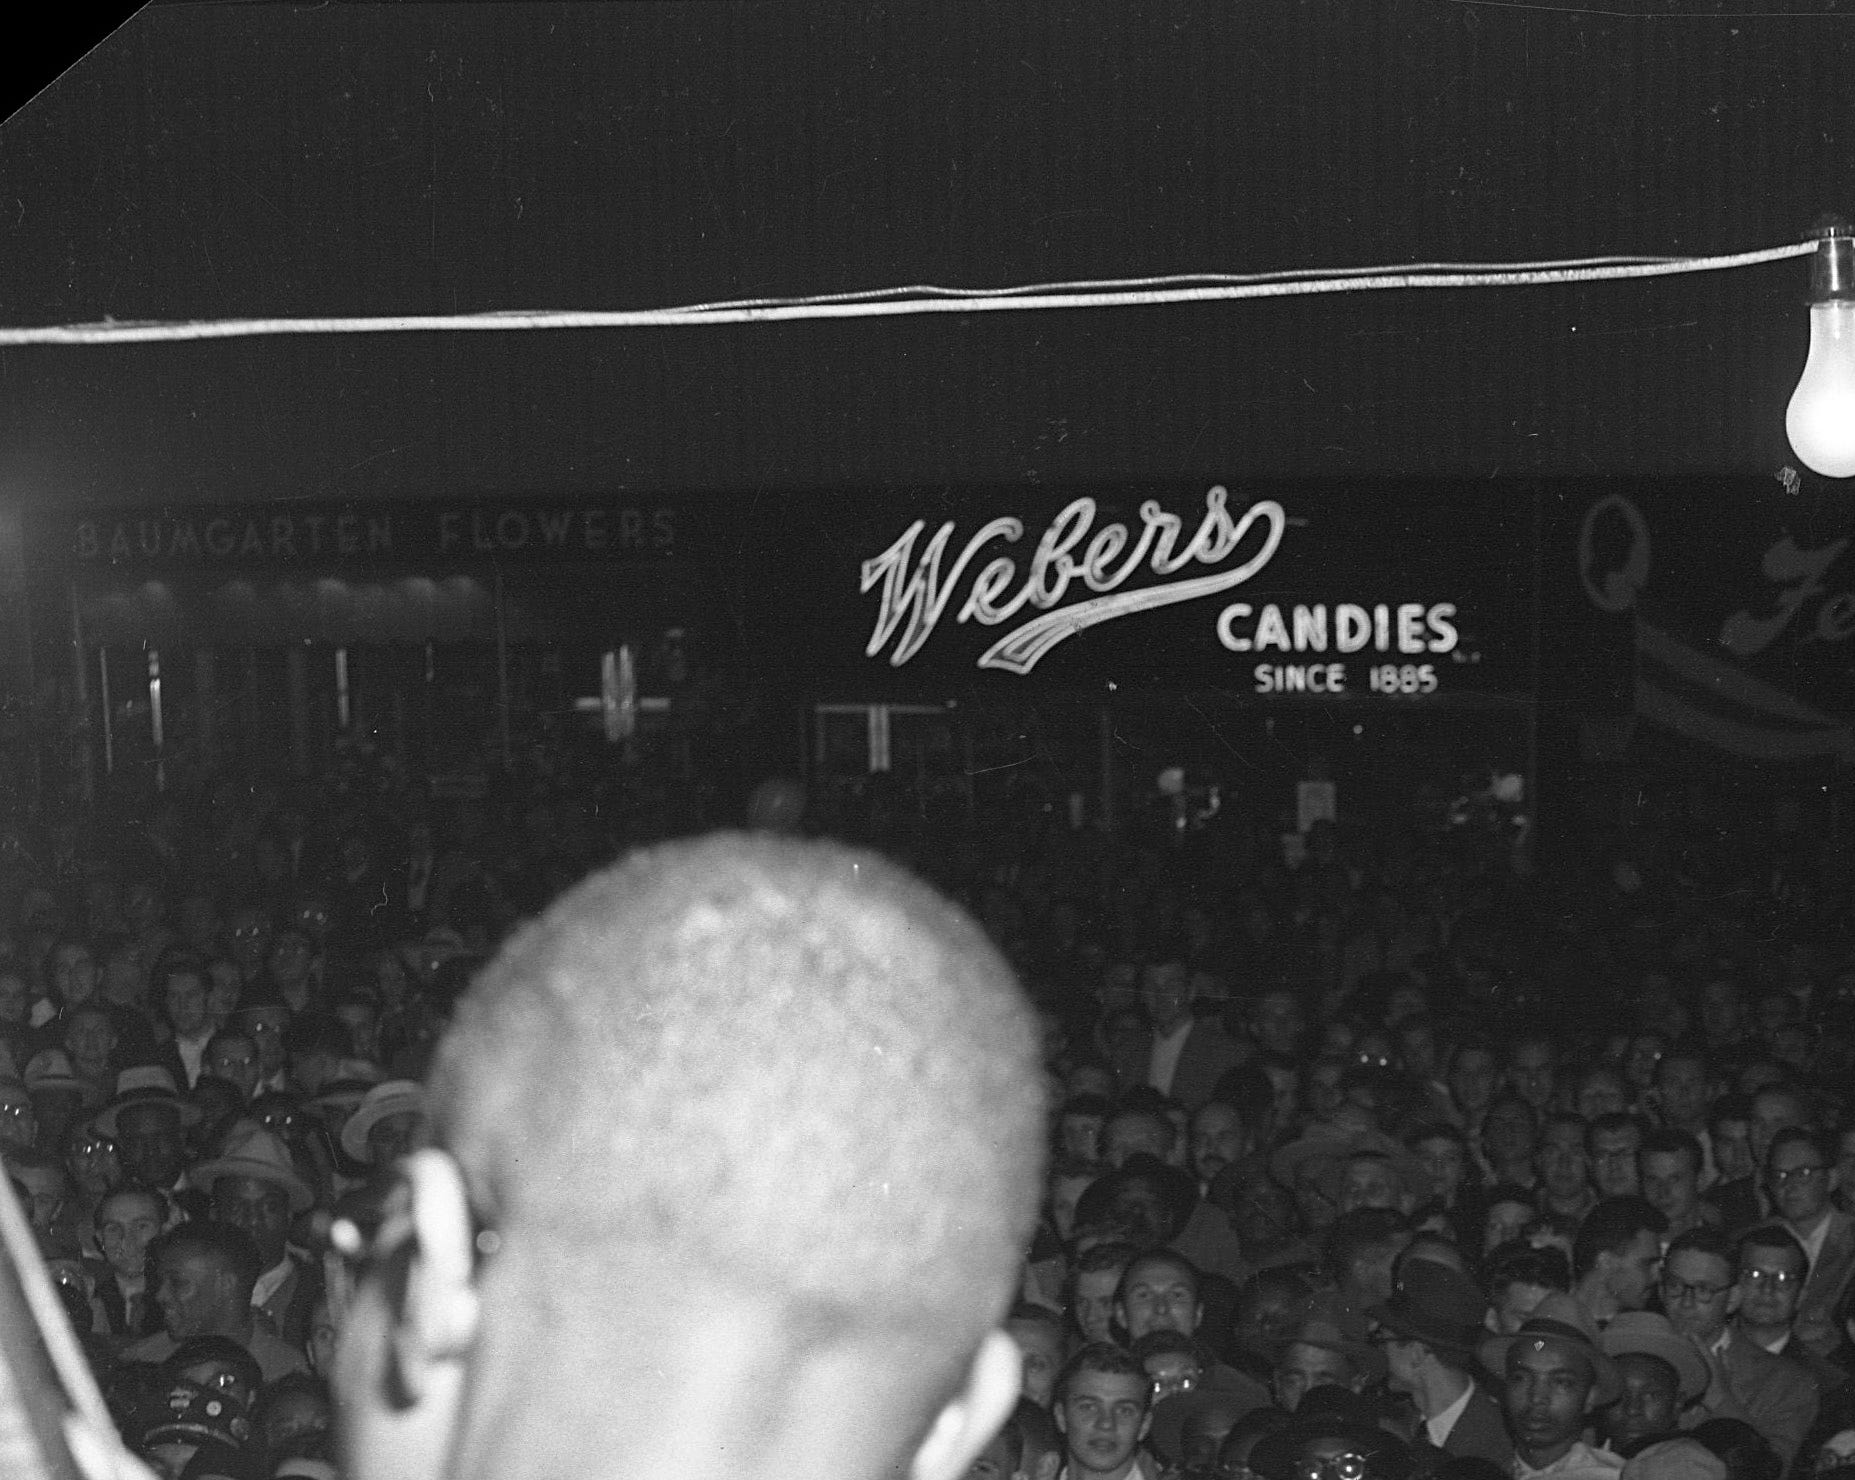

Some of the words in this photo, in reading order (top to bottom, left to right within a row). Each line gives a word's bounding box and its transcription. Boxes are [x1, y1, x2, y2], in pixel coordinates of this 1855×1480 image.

[74, 515, 393, 558] BAUMGARTEN
[437, 509, 678, 551] FLOWERS
[1216, 602, 1460, 654] CANDIES
[1253, 662, 1347, 694] SINCE
[1369, 662, 1440, 694] 1885
